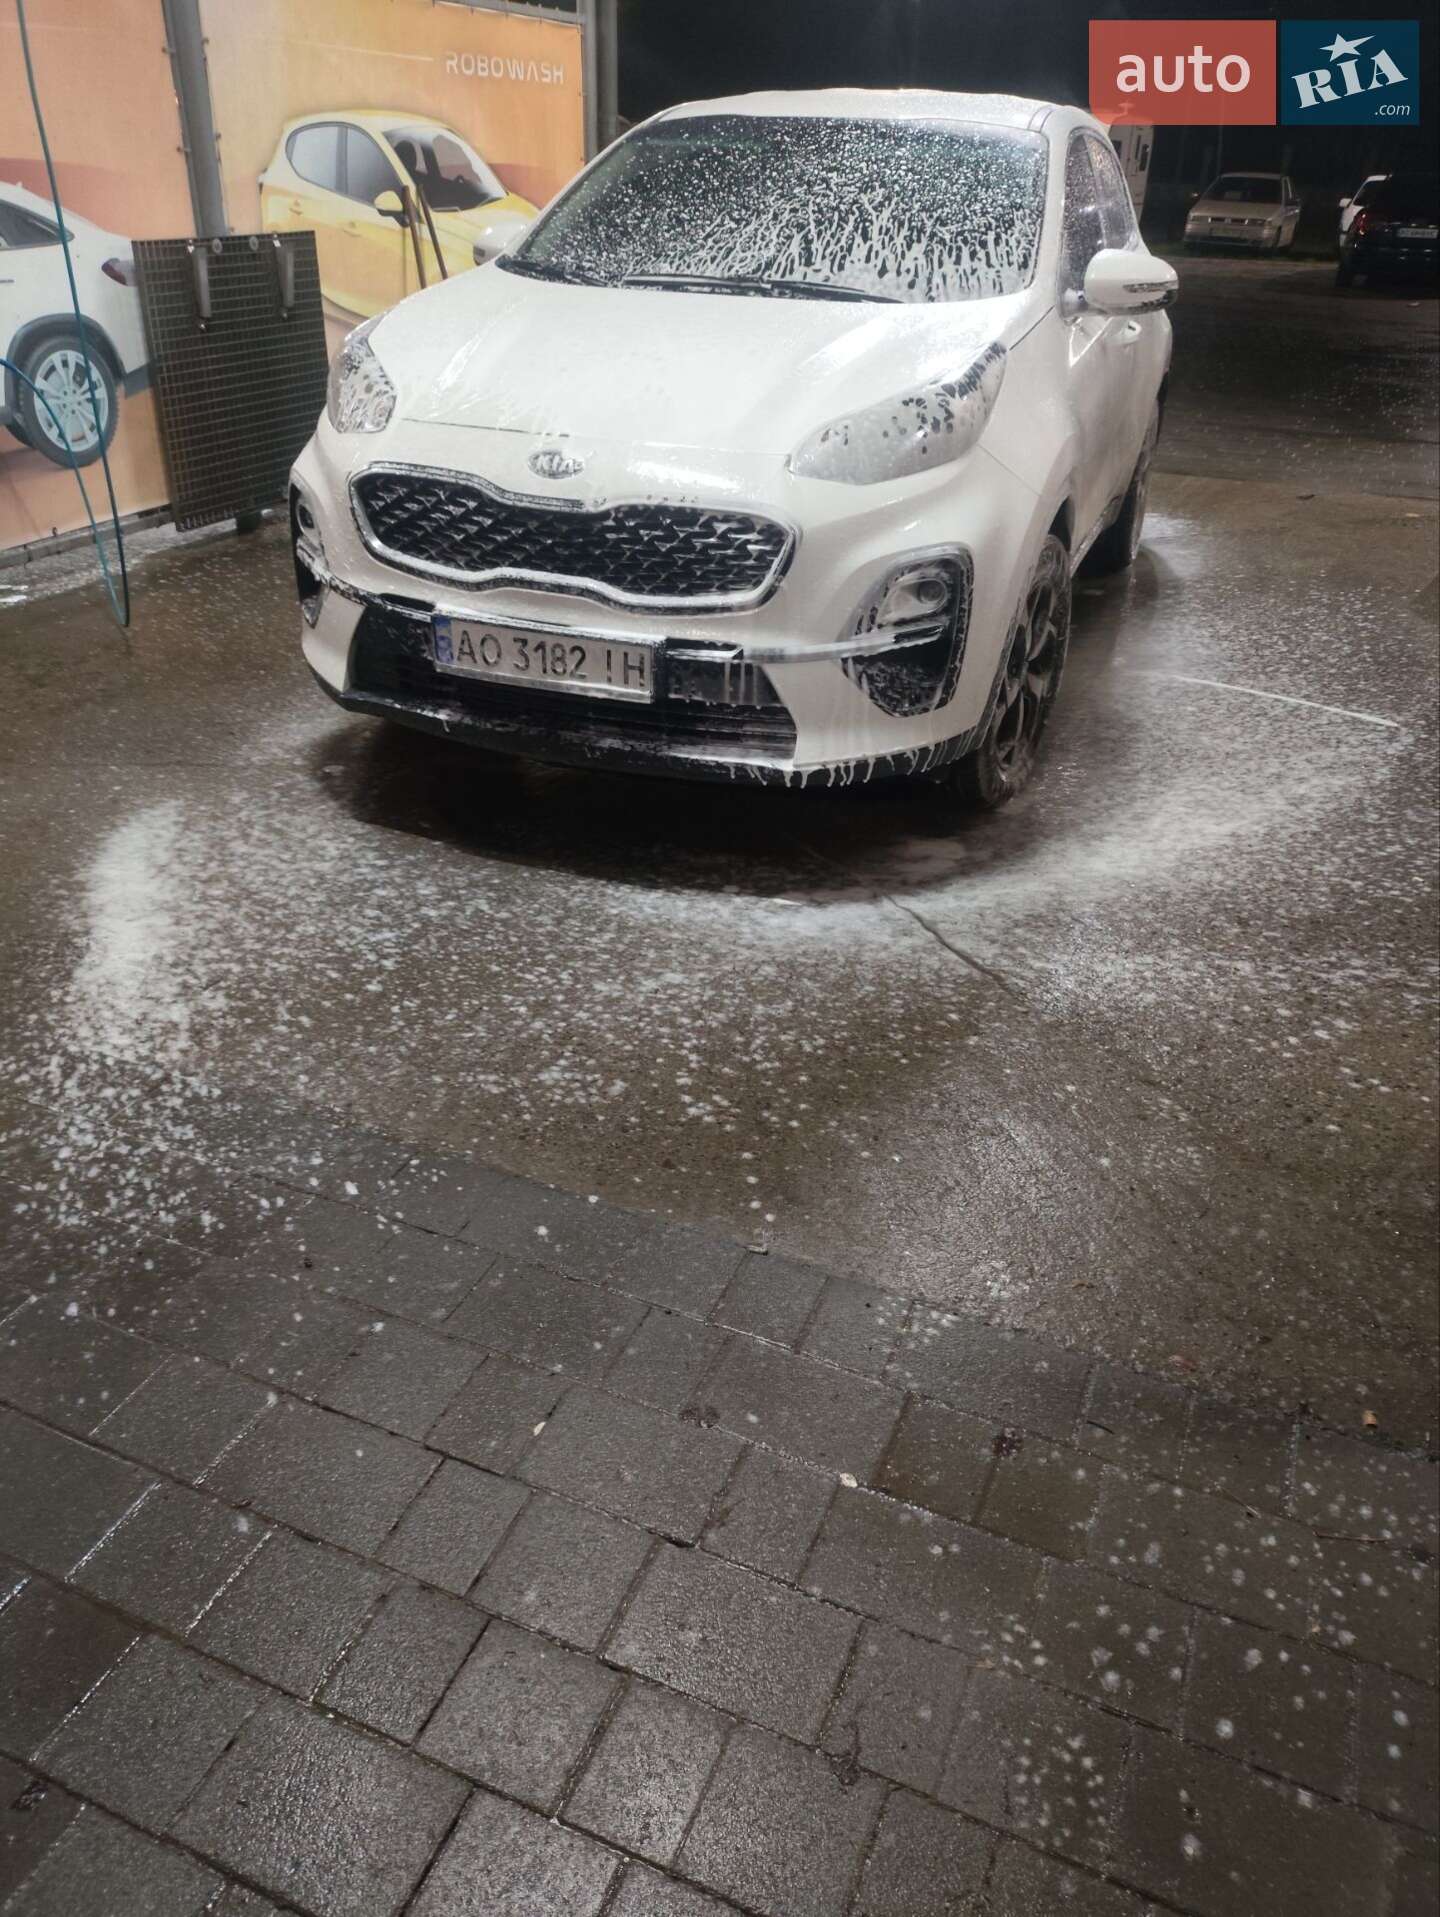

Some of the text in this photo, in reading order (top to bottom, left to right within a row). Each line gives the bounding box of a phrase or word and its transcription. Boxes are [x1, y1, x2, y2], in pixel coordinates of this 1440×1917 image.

[445, 51, 564, 85] ROBOWASH
[535, 453, 575, 475] KIA
[457, 630, 646, 687] AO 3182 IH
